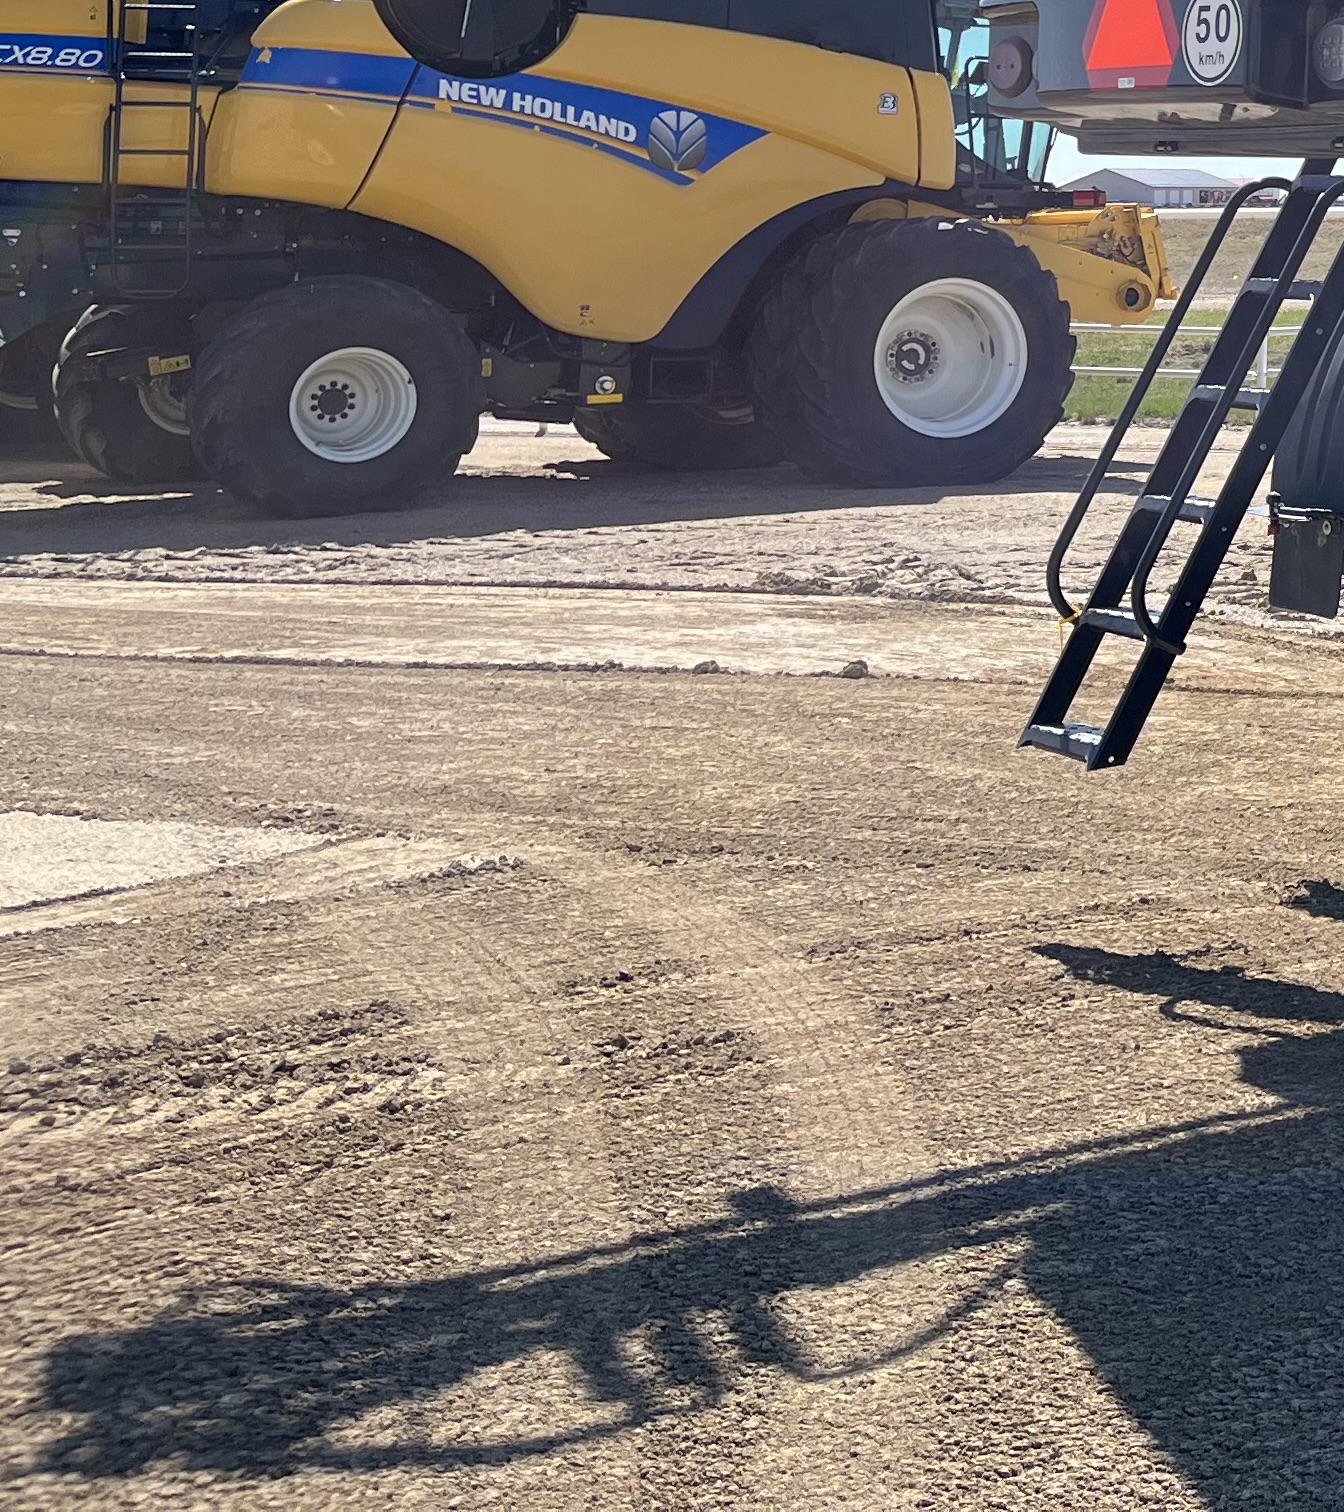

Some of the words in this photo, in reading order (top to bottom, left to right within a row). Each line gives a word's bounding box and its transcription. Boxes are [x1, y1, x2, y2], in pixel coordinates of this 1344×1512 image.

[1195, 3, 1231, 44] 50
[1198, 51, 1225, 66] km/h
[438, 78, 507, 108] NEW
[512, 92, 637, 143] HOLLAND
